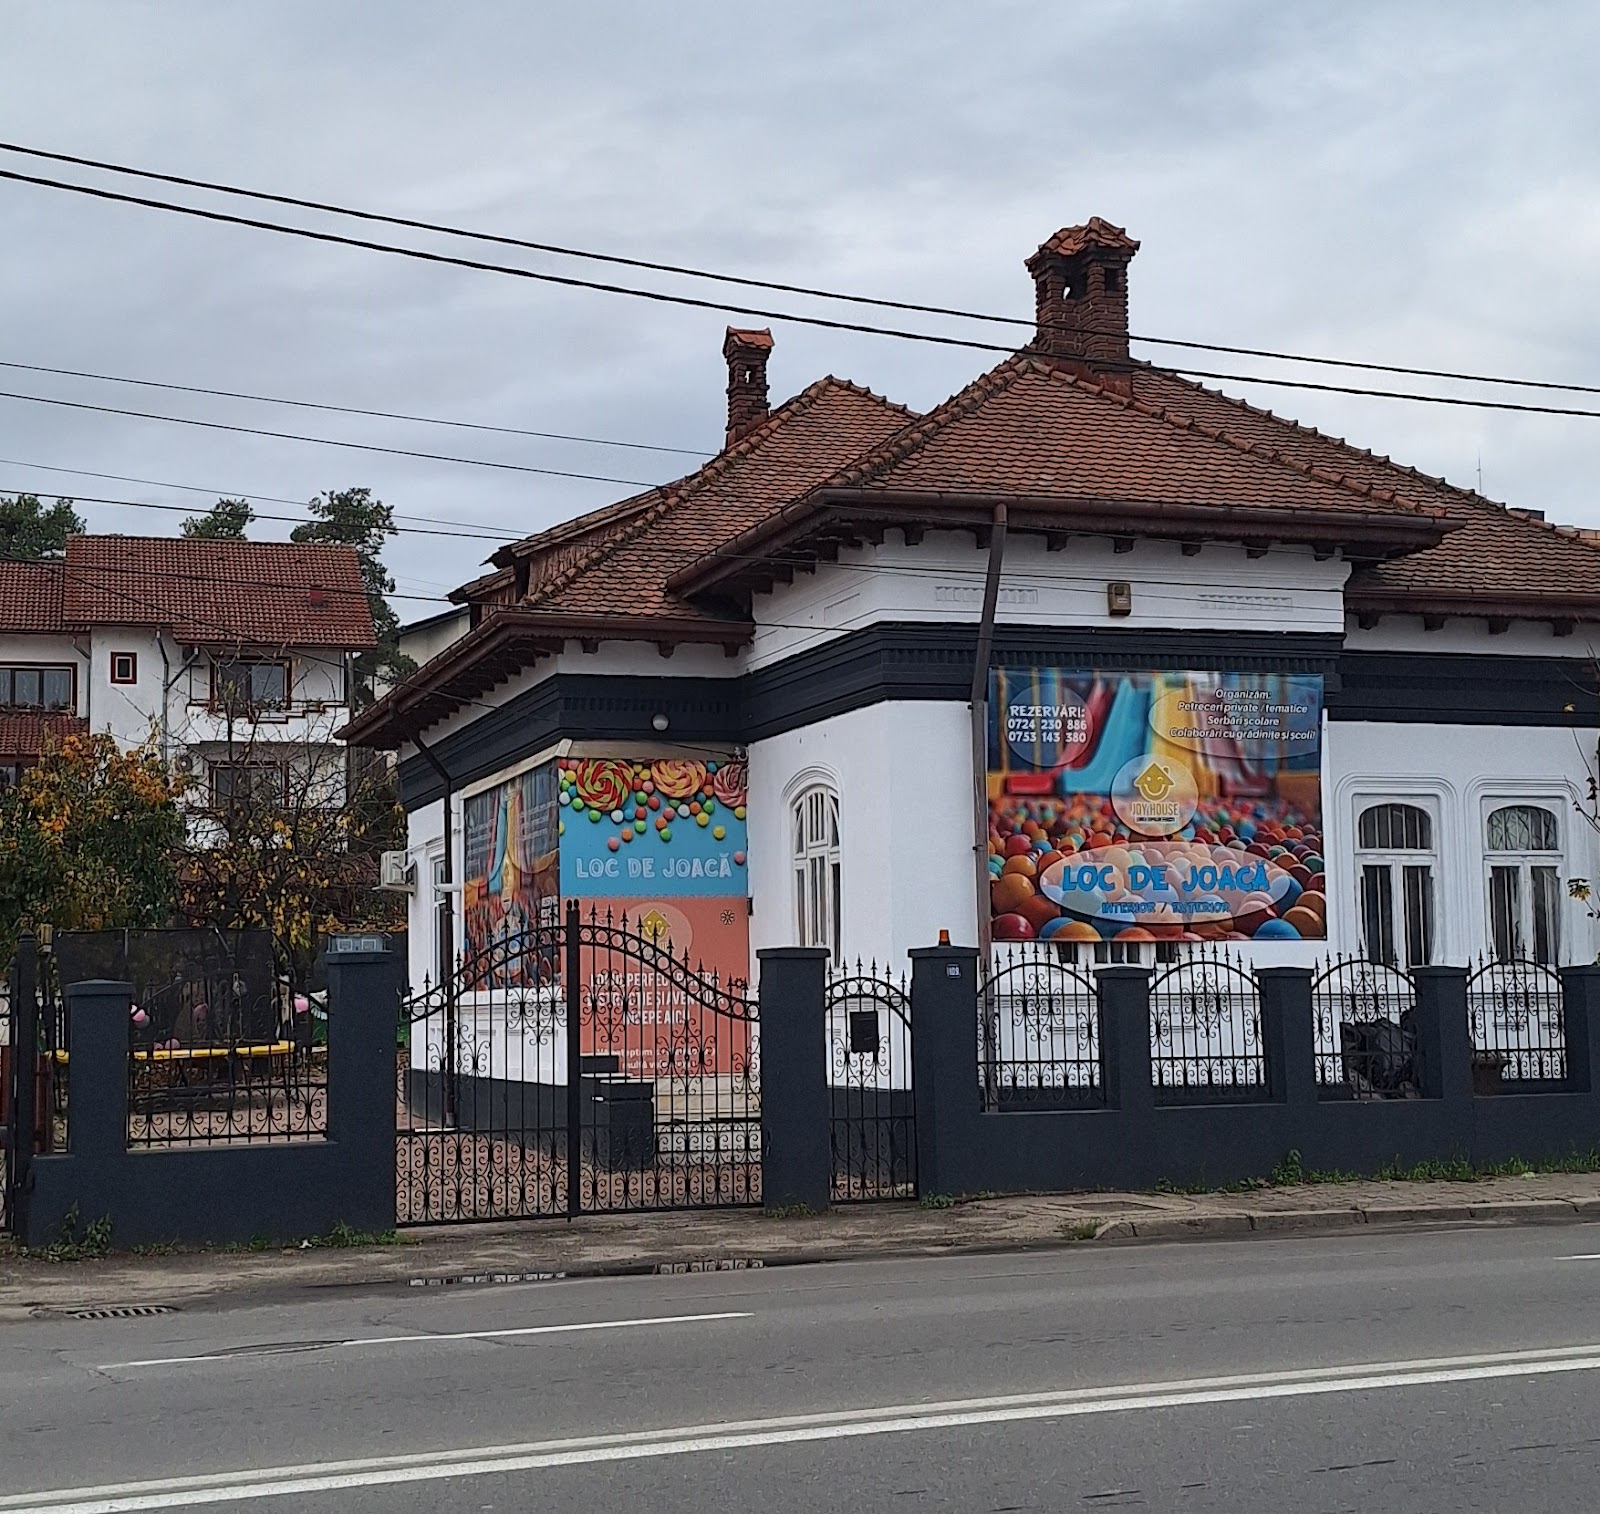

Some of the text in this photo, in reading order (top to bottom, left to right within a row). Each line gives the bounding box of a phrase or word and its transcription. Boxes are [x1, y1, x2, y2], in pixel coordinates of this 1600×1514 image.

[1009, 704, 1086, 718] REZERVĂRI:
[1178, 701, 1223, 712] Petreceri
[1223, 702, 1259, 714] private
[1265, 703, 1309, 713] tematice
[1007, 718, 1088, 730] 0724 230 886
[1008, 731, 1087, 743] 0753 143 380
[1222, 730, 1235, 739] cu
[1132, 802, 1179, 816] JOY HOUSE
[575, 852, 733, 879] LOC DE JOACĂ
[1062, 859, 1271, 892] LOC DE JOACĂ
[1101, 901, 1231, 914] INTERIOR / EXTERIOR
